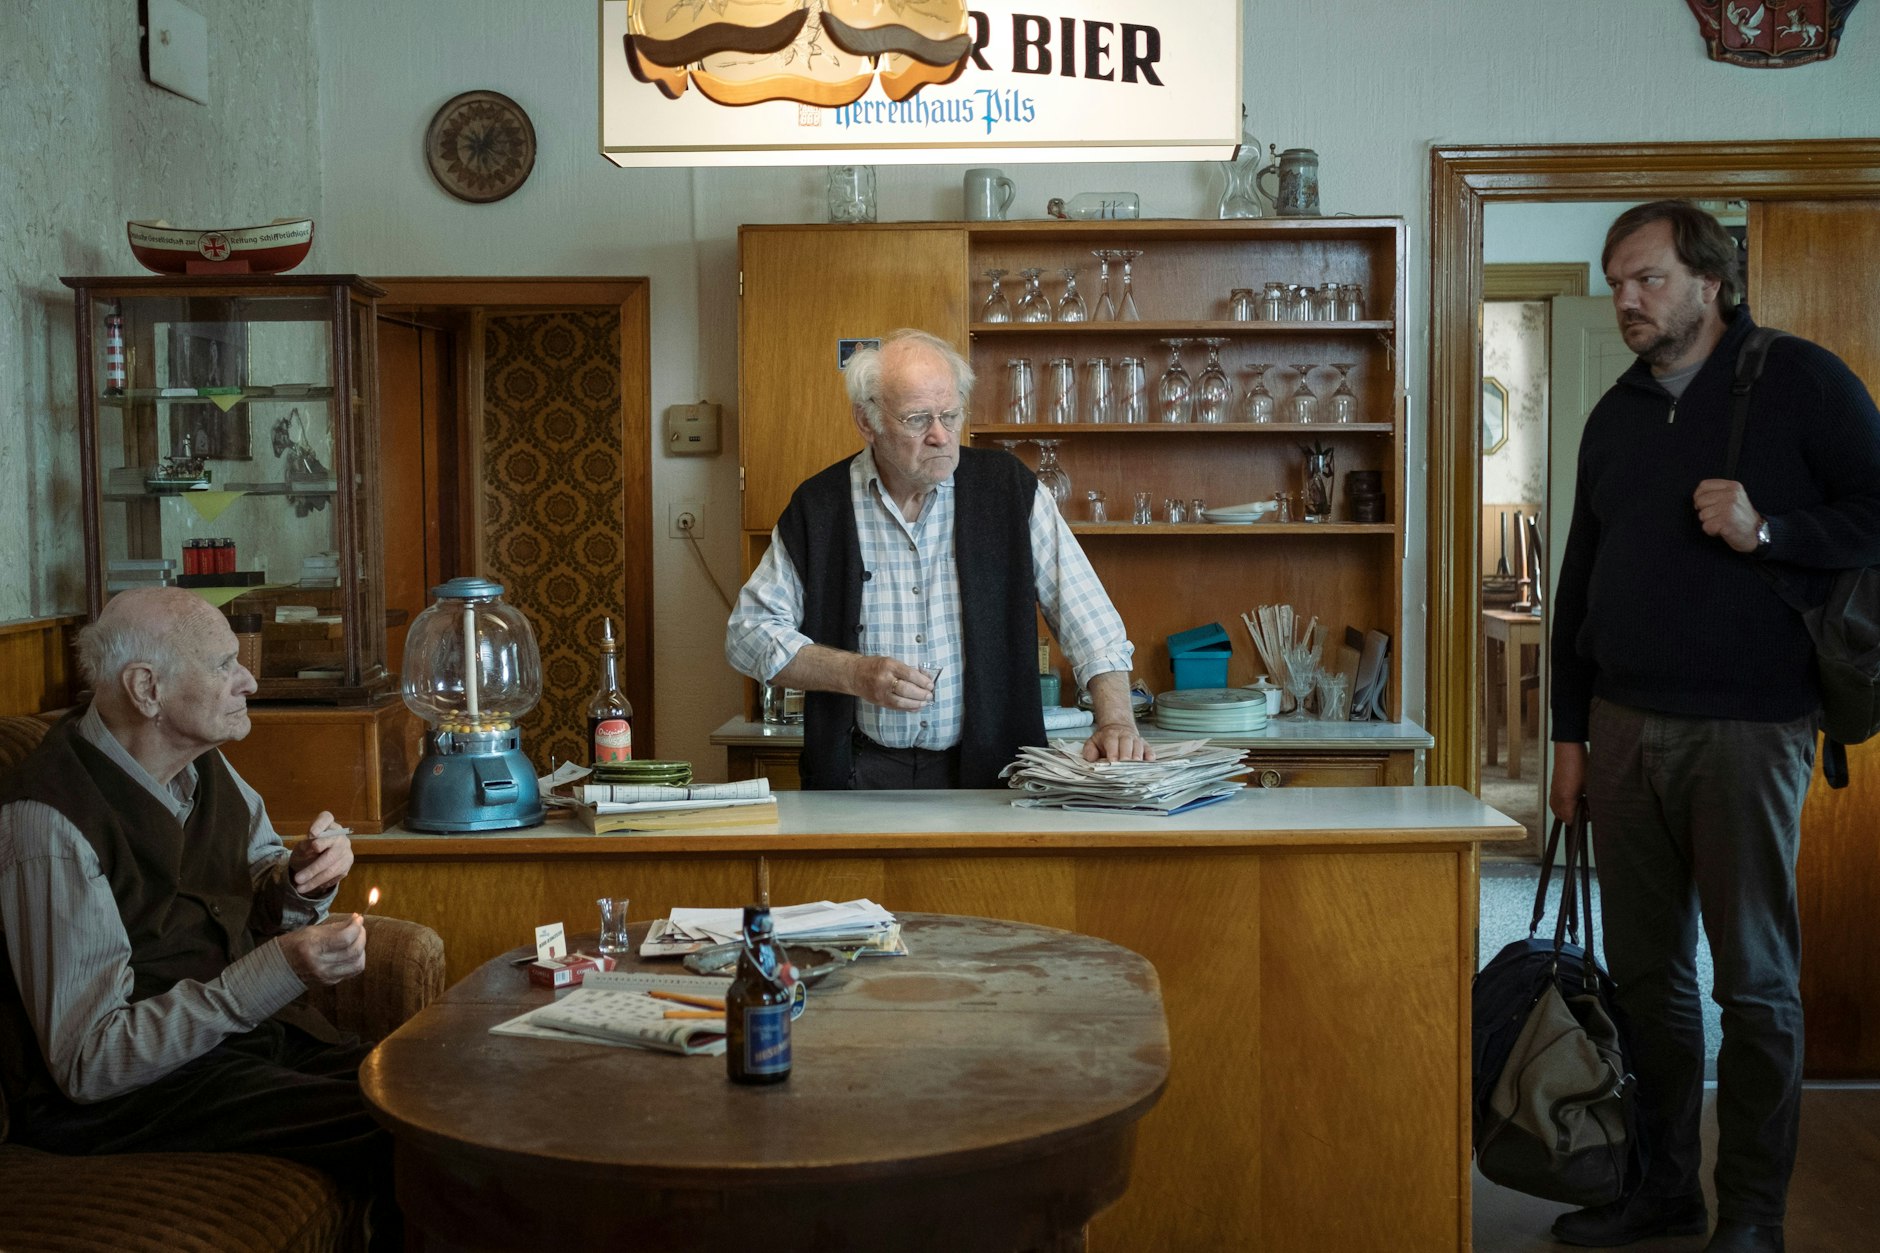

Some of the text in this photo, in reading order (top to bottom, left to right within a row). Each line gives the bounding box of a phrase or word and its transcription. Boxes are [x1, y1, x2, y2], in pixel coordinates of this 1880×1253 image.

[1011, 13, 1165, 87] BIER
[972, 88, 1036, 135] Pils
[598, 722, 627, 739] Original
